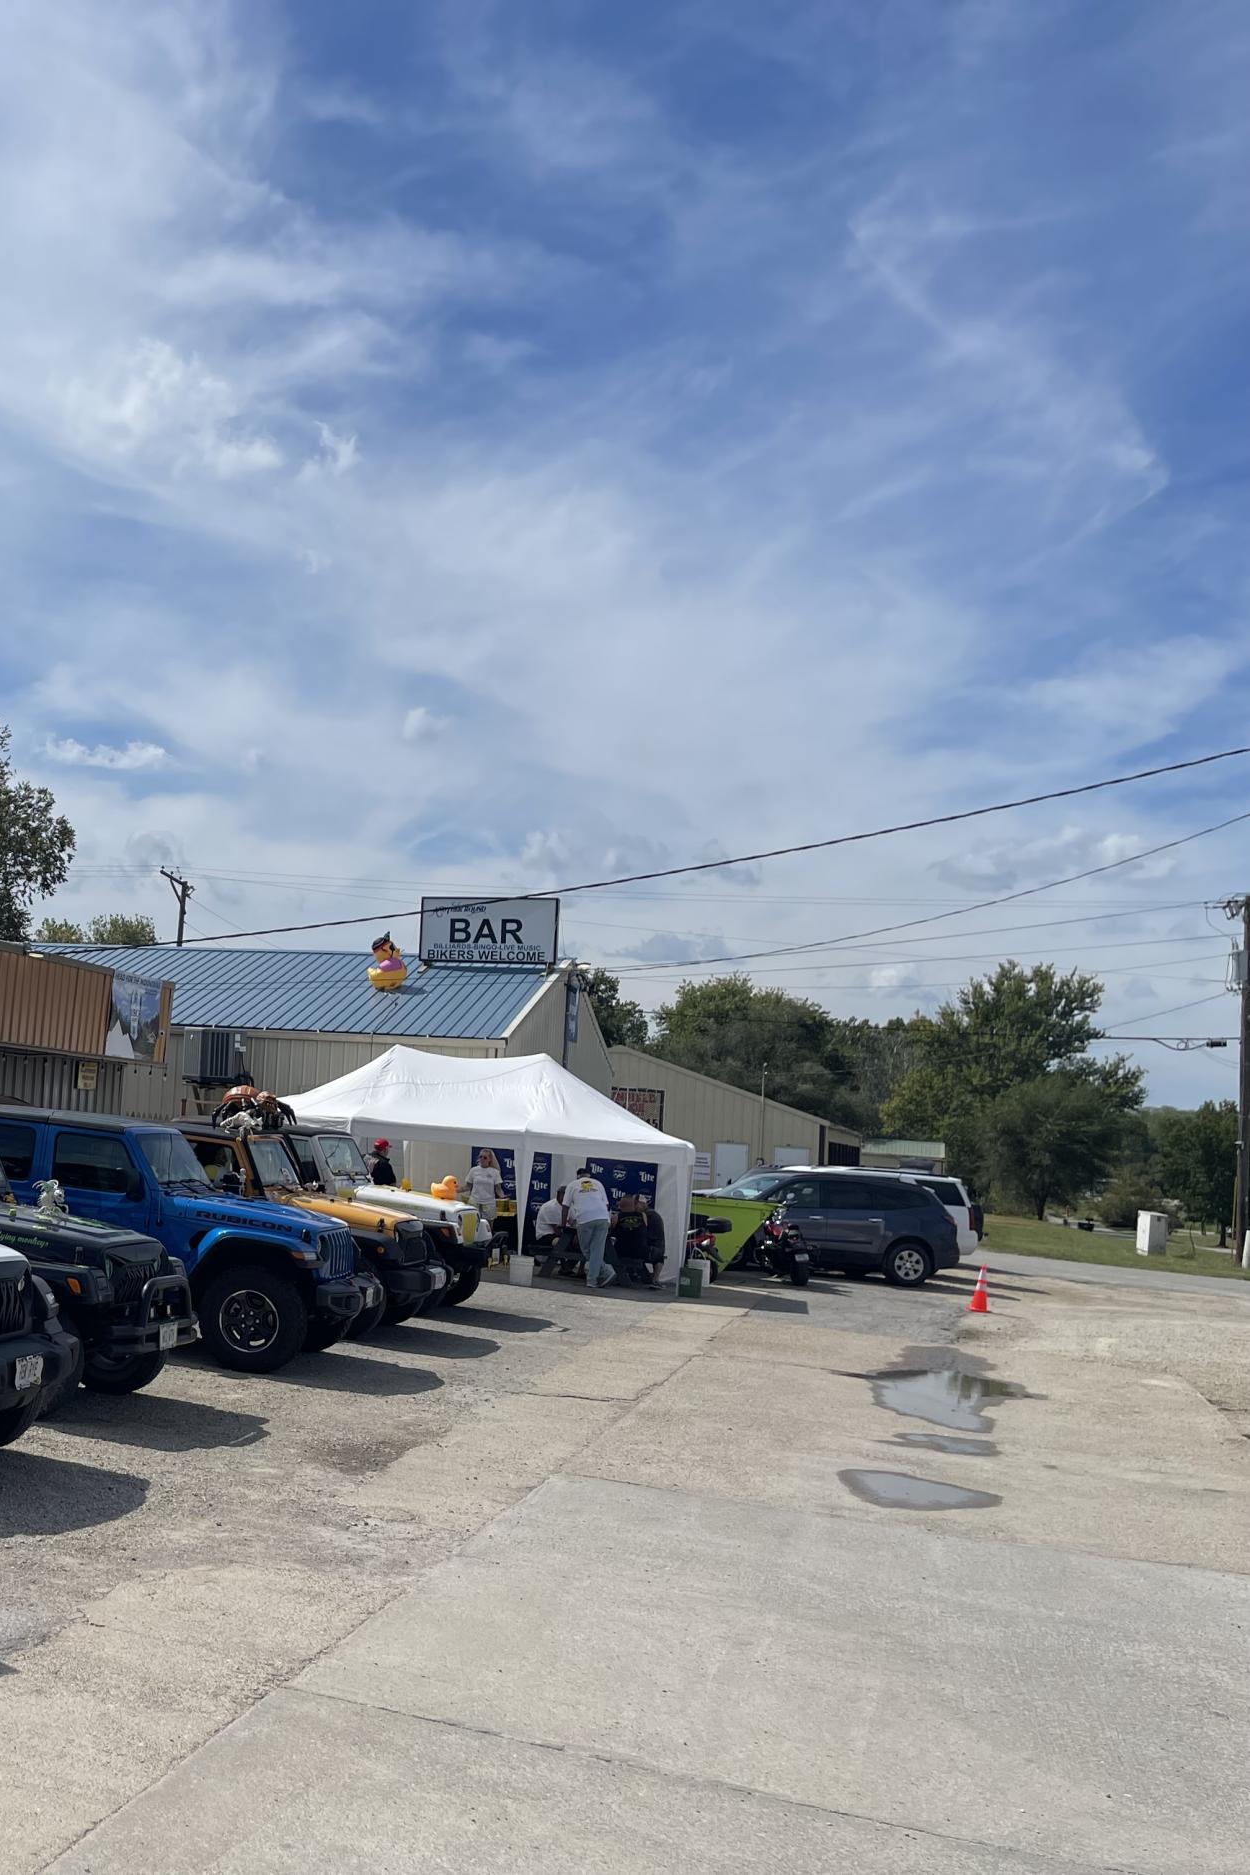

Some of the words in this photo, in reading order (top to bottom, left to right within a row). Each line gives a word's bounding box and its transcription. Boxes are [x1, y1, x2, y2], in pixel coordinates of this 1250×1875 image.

[449, 918, 524, 944] BAR
[427, 949, 474, 960] BIKERS
[478, 951, 546, 961] WELCOME
[589, 1163, 604, 1174] Lite
[638, 1171, 655, 1182] Lite
[531, 1180, 549, 1190] Lite
[194, 1210, 293, 1233] RUBICON
[17, 1235, 49, 1249] monkeys
